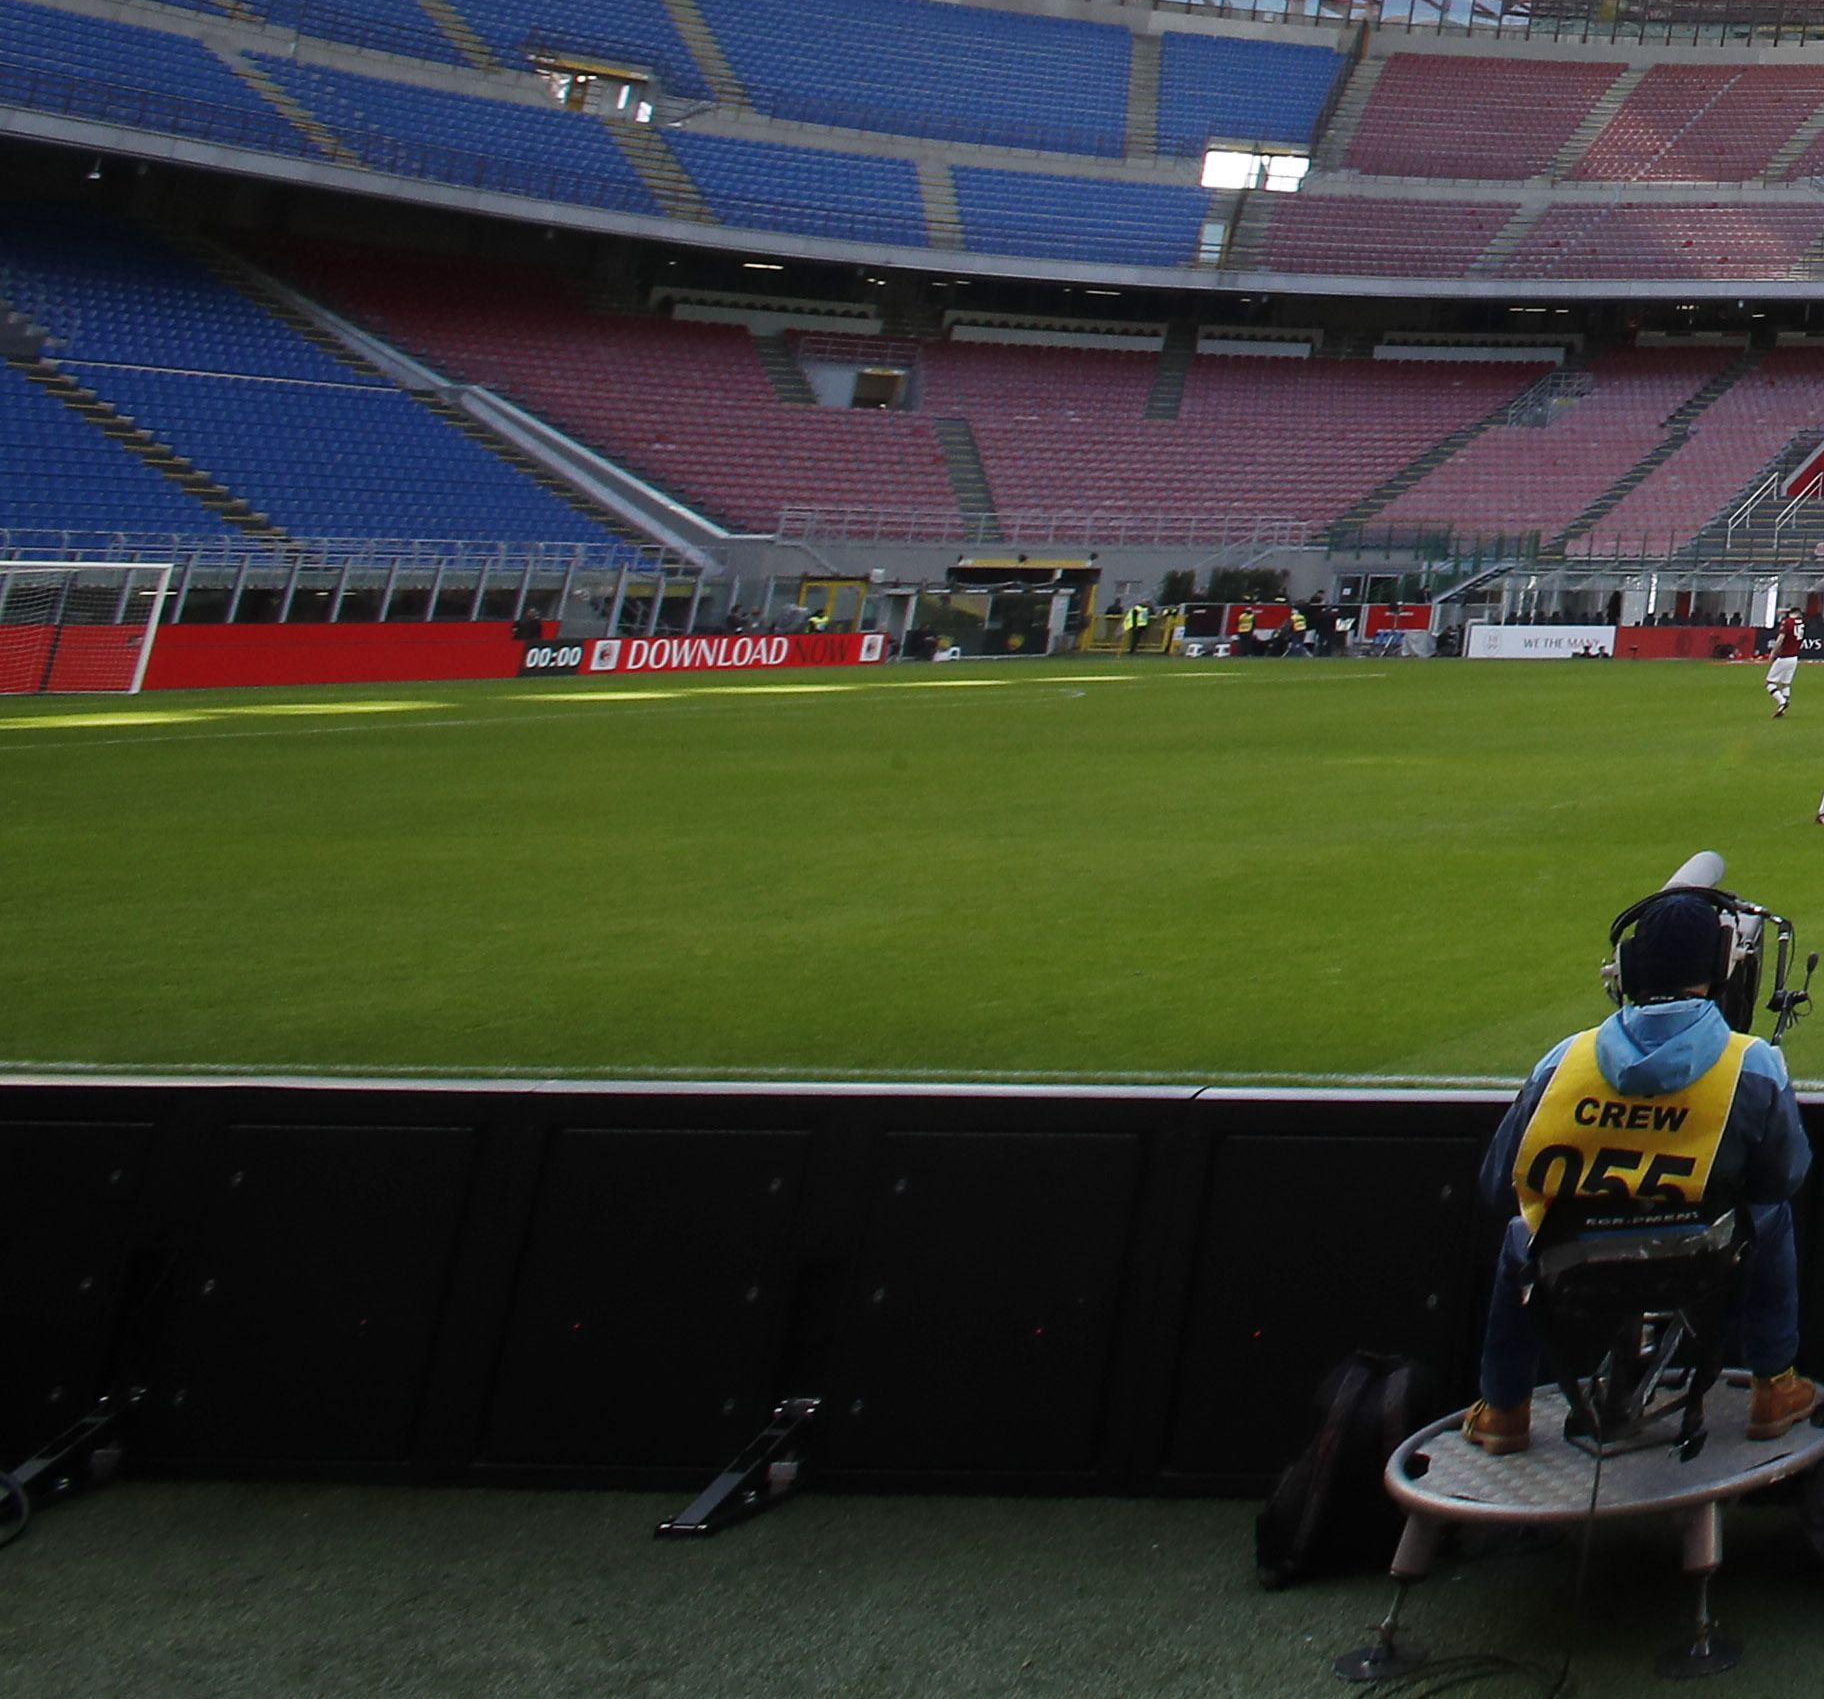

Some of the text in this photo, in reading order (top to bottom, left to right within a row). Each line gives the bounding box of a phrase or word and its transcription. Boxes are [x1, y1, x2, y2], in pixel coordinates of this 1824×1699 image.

[525, 646, 582, 669] 00:00
[626, 637, 848, 669] DOWNLOAD NOW
[1523, 638, 1541, 648] WE
[1544, 638, 1562, 648] THE
[1574, 1097, 1691, 1133] CREW
[1526, 1144, 1697, 1201] 055
